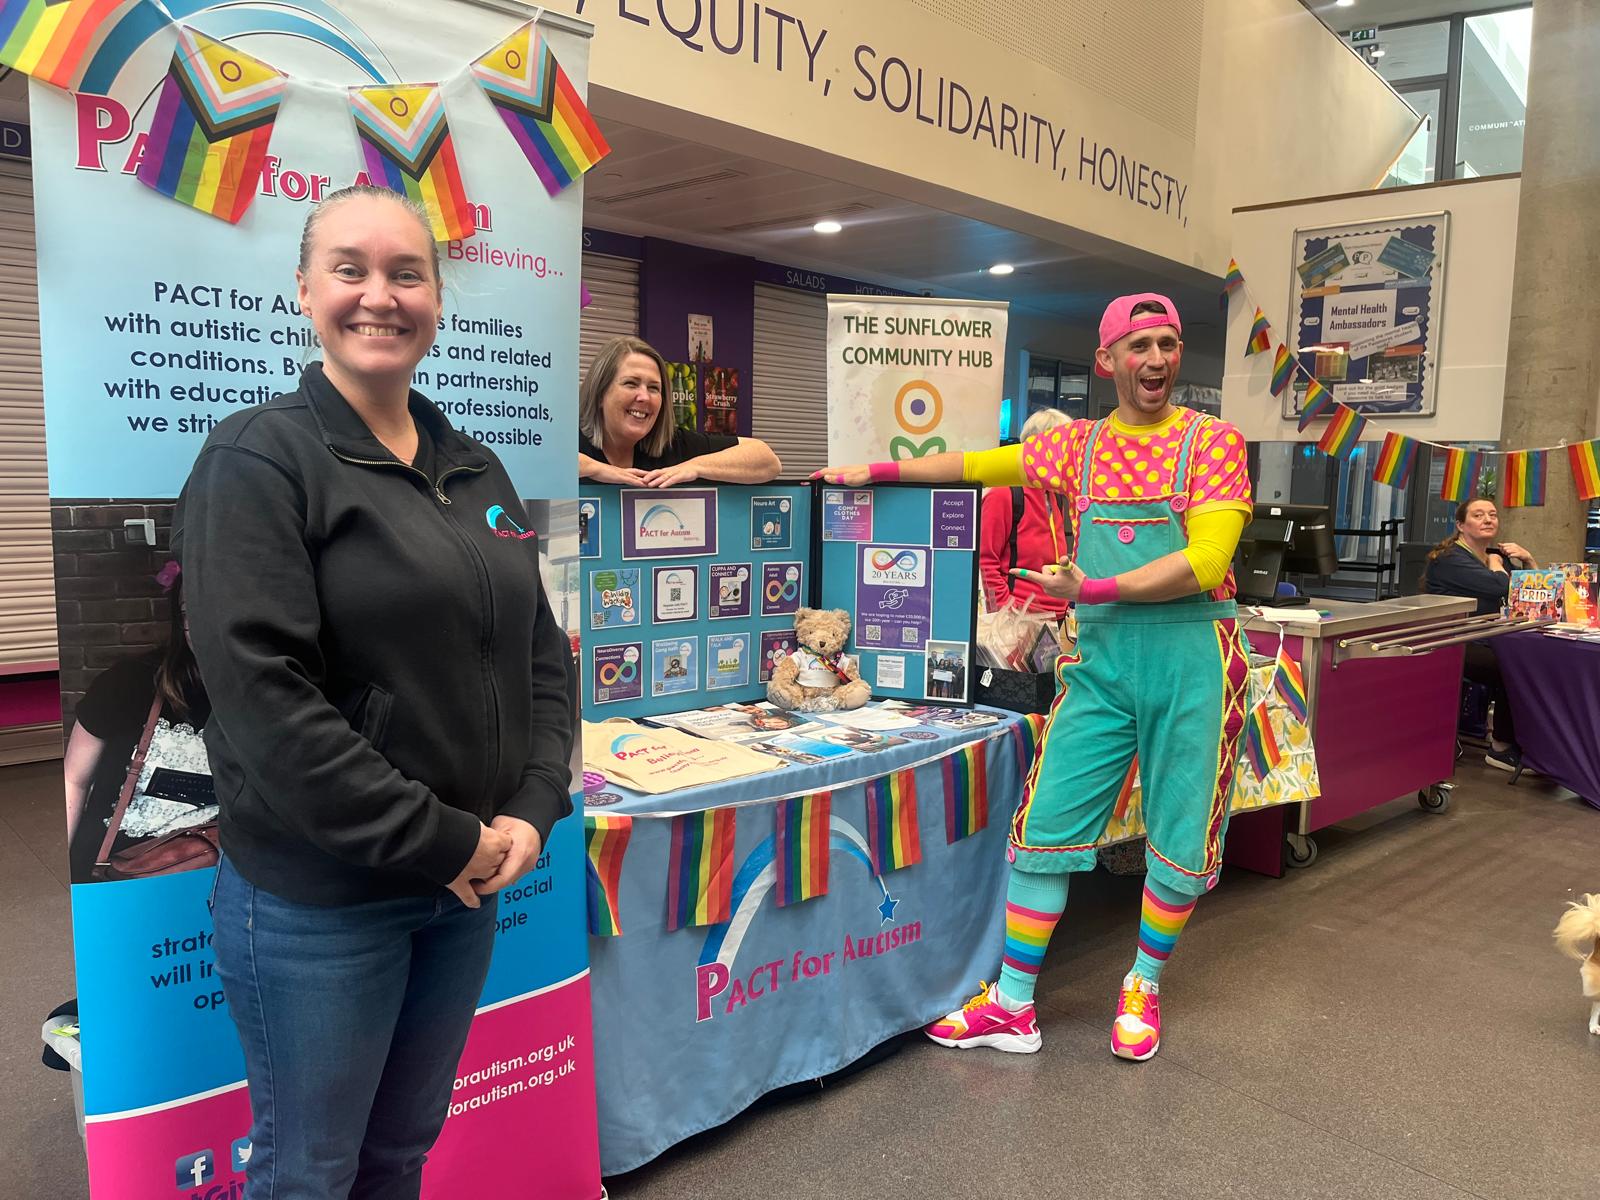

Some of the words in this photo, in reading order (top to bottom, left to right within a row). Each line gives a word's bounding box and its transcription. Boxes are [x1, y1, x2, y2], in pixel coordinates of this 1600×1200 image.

[853, 45, 1066, 181] SOLIDARITY,
[1079, 137, 1188, 228] HONESTY,
[258, 154, 330, 203] for
[447, 238, 564, 278] Believing...
[786, 270, 826, 290] SALADS
[154, 281, 223, 308] PACT
[230, 289, 263, 312] for
[1331, 305, 1358, 317] Mental
[1360, 303, 1387, 315] Health
[104, 312, 161, 335] with
[170, 319, 261, 343] autistic
[451, 314, 523, 338] families
[843, 315, 879, 334] THE
[884, 317, 992, 338] SUNFLOWER
[1329, 317, 1387, 330] Ambassadors
[130, 349, 274, 375] conditions.
[447, 344, 485, 361] and
[490, 347, 551, 368] related
[842, 346, 953, 367] COMMUNITY
[958, 350, 993, 368] HUB
[103, 377, 161, 400] with
[436, 371, 539, 396] partnership
[672, 390, 695, 404] pple
[704, 392, 738, 403] Strawberry
[713, 399, 731, 407] Crush
[433, 398, 554, 422] professionals,
[127, 415, 169, 433] we
[472, 428, 543, 446] possible
[640, 527, 658, 537] PACT
[872, 570, 881, 578] 20
[883, 571, 917, 580] YEARS
[1522, 572, 1554, 590] ABC
[1521, 589, 1552, 600] PRIDE
[504, 876, 553, 905] social
[150, 963, 192, 989] will
[695, 958, 785, 1023] PACT
[791, 950, 836, 983] for
[842, 919, 922, 968] Autism
[453, 1034, 575, 1091] orautism.org.uk
[447, 1058, 576, 1118] forautism.org.uk
